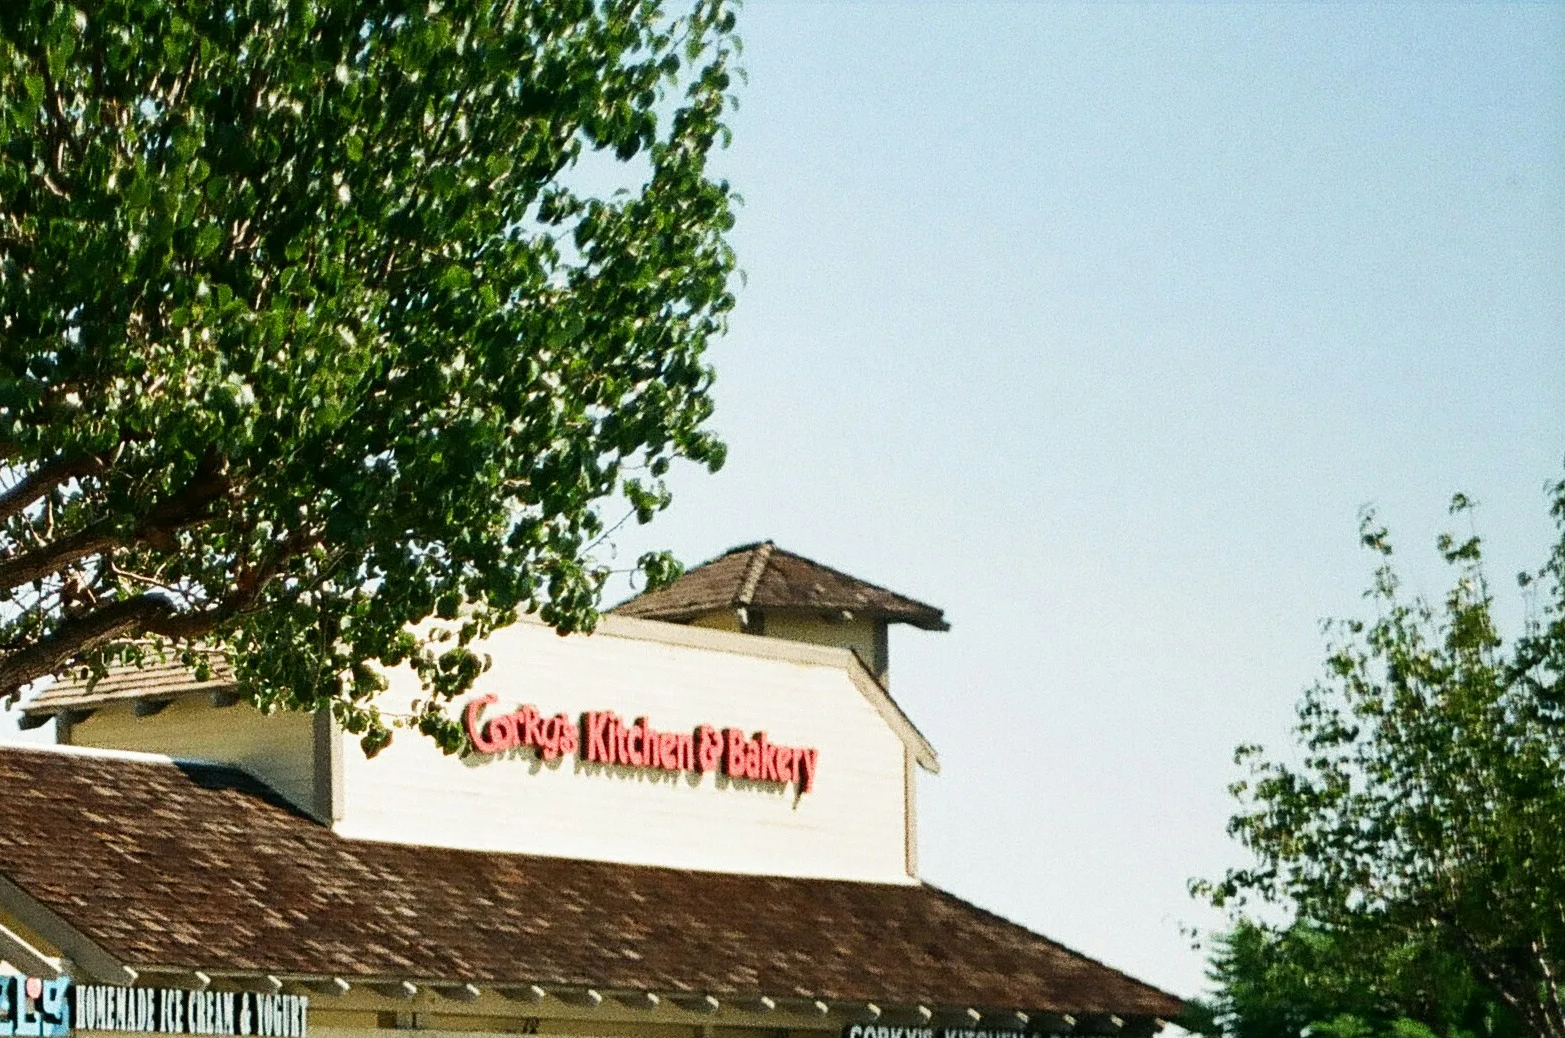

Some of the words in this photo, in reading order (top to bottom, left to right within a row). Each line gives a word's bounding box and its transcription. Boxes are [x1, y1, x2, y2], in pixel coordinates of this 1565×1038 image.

[587, 709, 694, 772] Kitchen
[700, 723, 725, 773] &
[727, 727, 820, 795] Bakery
[75, 984, 155, 1032] HOMEMADE
[160, 988, 184, 1033] ICE
[187, 990, 235, 1035] CREAM
[239, 992, 252, 1036] &
[255, 993, 309, 1038] YOGURT
